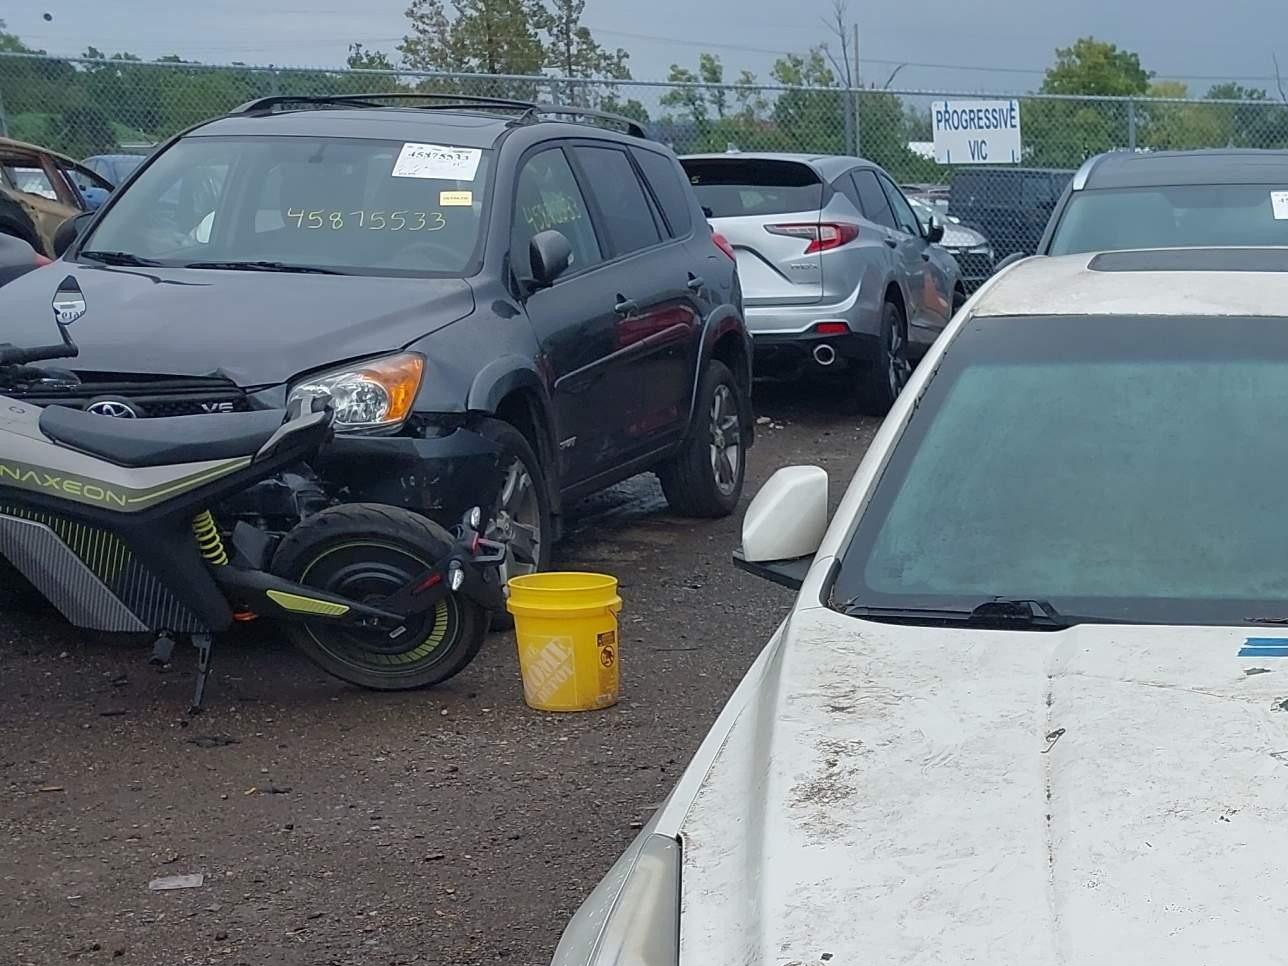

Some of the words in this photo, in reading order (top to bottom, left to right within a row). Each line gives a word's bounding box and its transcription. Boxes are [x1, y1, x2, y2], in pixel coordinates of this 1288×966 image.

[936, 108, 1017, 130] PROGRESSIVE
[968, 139, 988, 160] VIC
[287, 207, 446, 231] 45875533
[201, 402, 234, 413] V6
[0, 464, 127, 506] NAXEON
